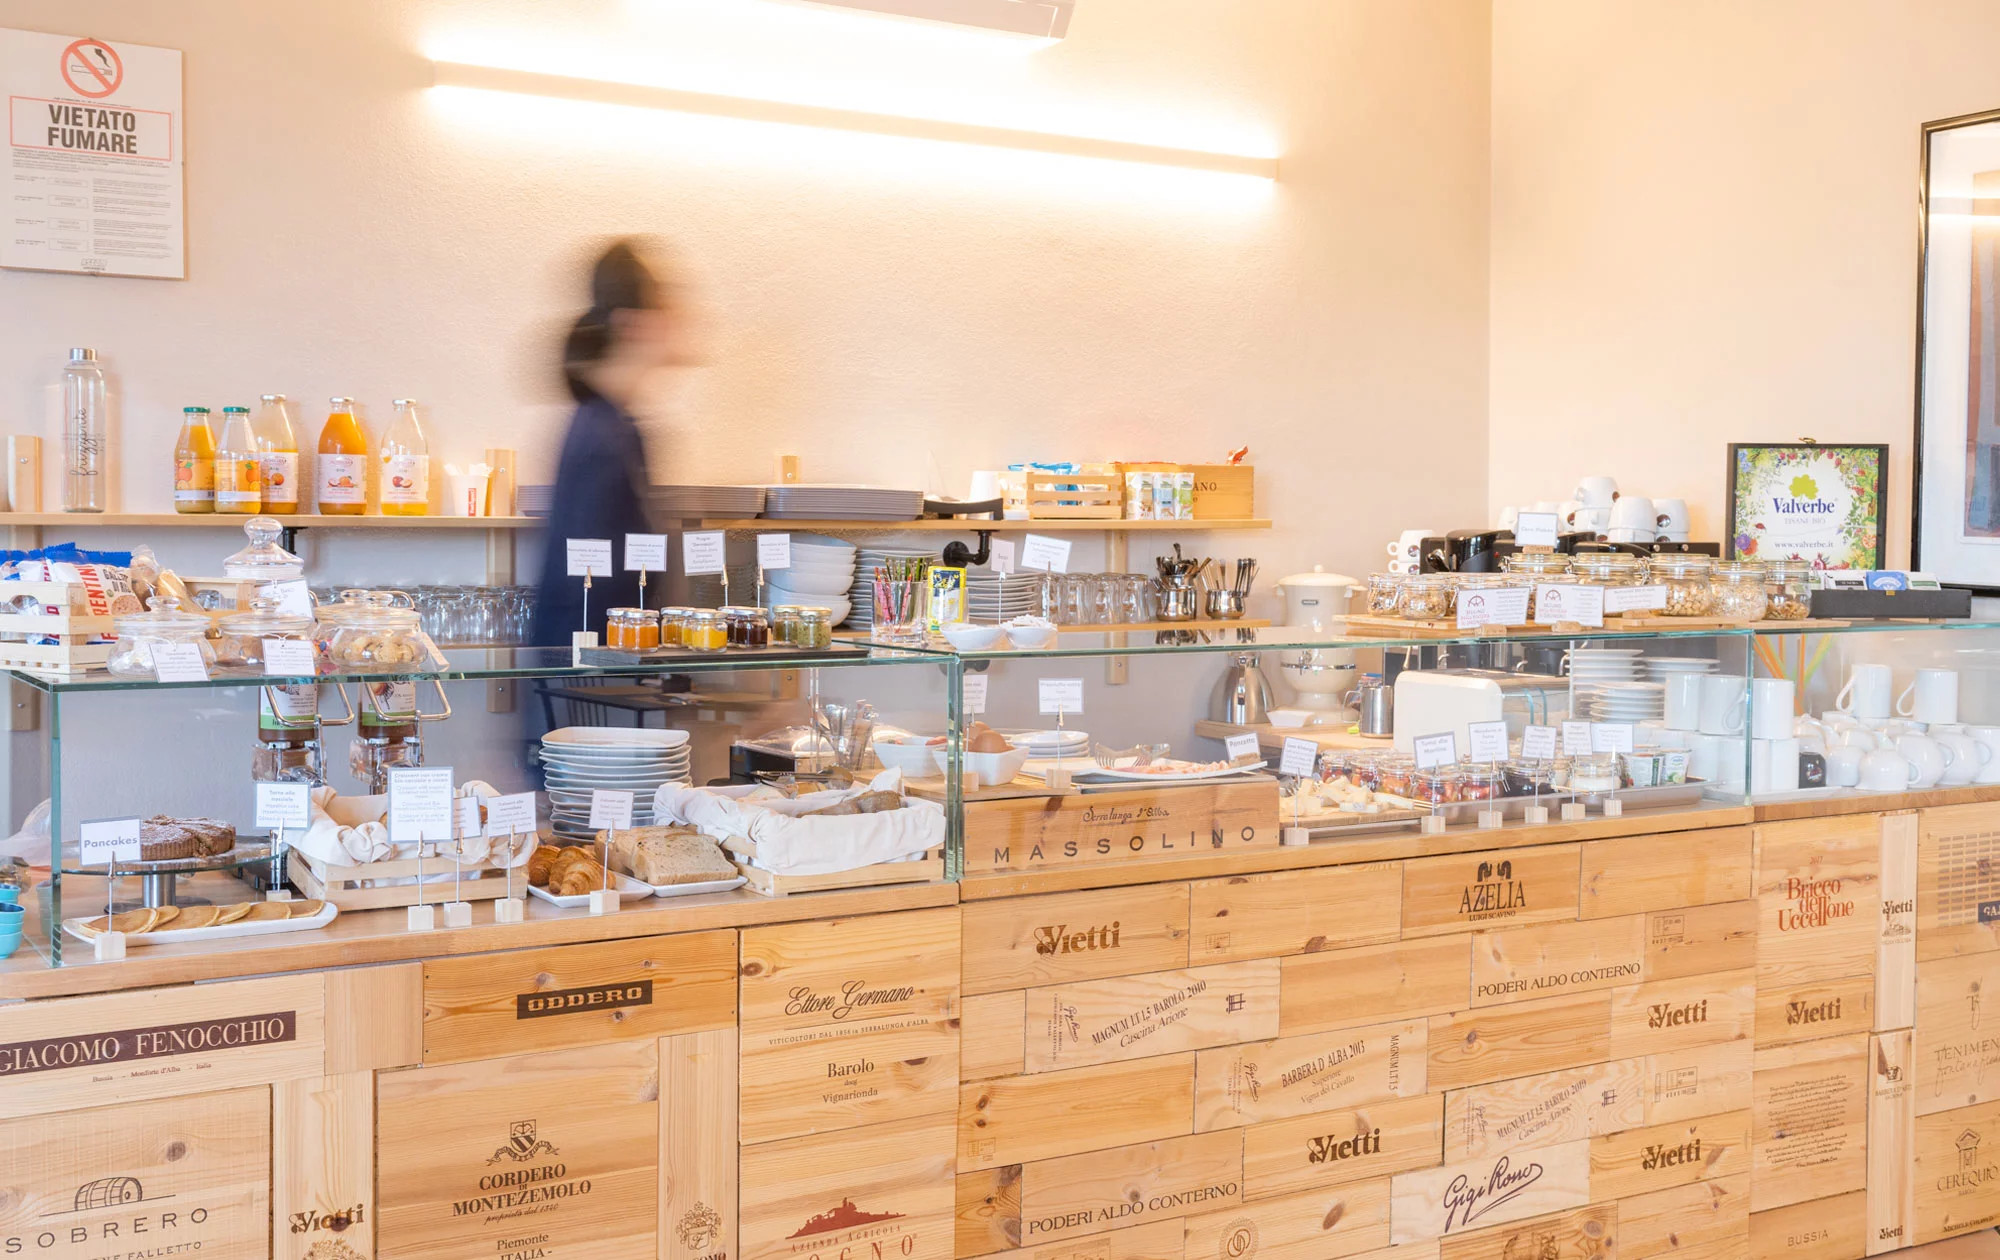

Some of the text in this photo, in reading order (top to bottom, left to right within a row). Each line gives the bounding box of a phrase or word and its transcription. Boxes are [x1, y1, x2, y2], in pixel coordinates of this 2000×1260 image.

[48, 104, 136, 132] VIETATO
[47, 126, 137, 154] FUMARE
[1773, 497, 1835, 514] Valverbe
[1774, 540, 1834, 548] www.valverbe.it
[84, 836, 138, 849] Pancakes
[994, 826, 1255, 863] MASSOLINO
[1458, 880, 1527, 914] AZELIA
[1787, 876, 1842, 901] Bricco
[1488, 910, 1516, 920] SCAVINO
[1778, 900, 1854, 931] Uccellone
[1882, 900, 1913, 915] Vietti
[1033, 920, 1121, 955] Vietti
[1478, 963, 1641, 997] PODERI ALDO CONTERNO
[527, 987, 642, 1012] ODDERO
[784, 980, 915, 1019] Ettore Germano
[1091, 1019, 1129, 1046] MAGNUM
[1152, 990, 1186, 1015] BAROLO
[1186, 980, 1207, 998] 2010
[1785, 997, 1841, 1026] Vietti
[1119, 1007, 1189, 1048] Cascina Arione
[1648, 1000, 1708, 1029] Vietti
[0, 1017, 285, 1073] GIACOMO FENOCCHIO
[768, 1033, 817, 1046] VITICOLTORI
[819, 1031, 833, 1039] DAL
[861, 1022, 904, 1034] SERRALUNGA
[1281, 1063, 1318, 1088] BARBERA
[1328, 1047, 1349, 1068] ALBA
[1349, 1039, 1365, 1059] 2013
[1390, 1034, 1399, 1068] MAGNUM
[160, 1065, 181, 1075] d'Alba
[827, 1058, 875, 1078] Barolo
[822, 1087, 878, 1104] Vignarionda
[1496, 1114, 1527, 1138] MAGNUM
[1544, 1089, 1571, 1112] BAROLO
[1306, 1128, 1381, 1164] Vietti
[1640, 1138, 1701, 1171] Vietti
[479, 1163, 567, 1191] CORDERO
[518, 1183, 528, 1191] DI
[452, 1179, 592, 1217] MONTEZEMOLO
[1028, 1182, 1238, 1234] PODERI ALDO CONTERNO
[1443, 1155, 1544, 1233] Gigi Rosso
[5, 1207, 208, 1254] SOBRERO
[289, 1203, 366, 1236] Vietti
[128, 1240, 202, 1260] FALLETTO
[496, 1232, 549, 1251] Piemonte
[791, 1224, 901, 1253] AZIENDA AGRICOLA
[1787, 1229, 1829, 1247] BUSSIA
